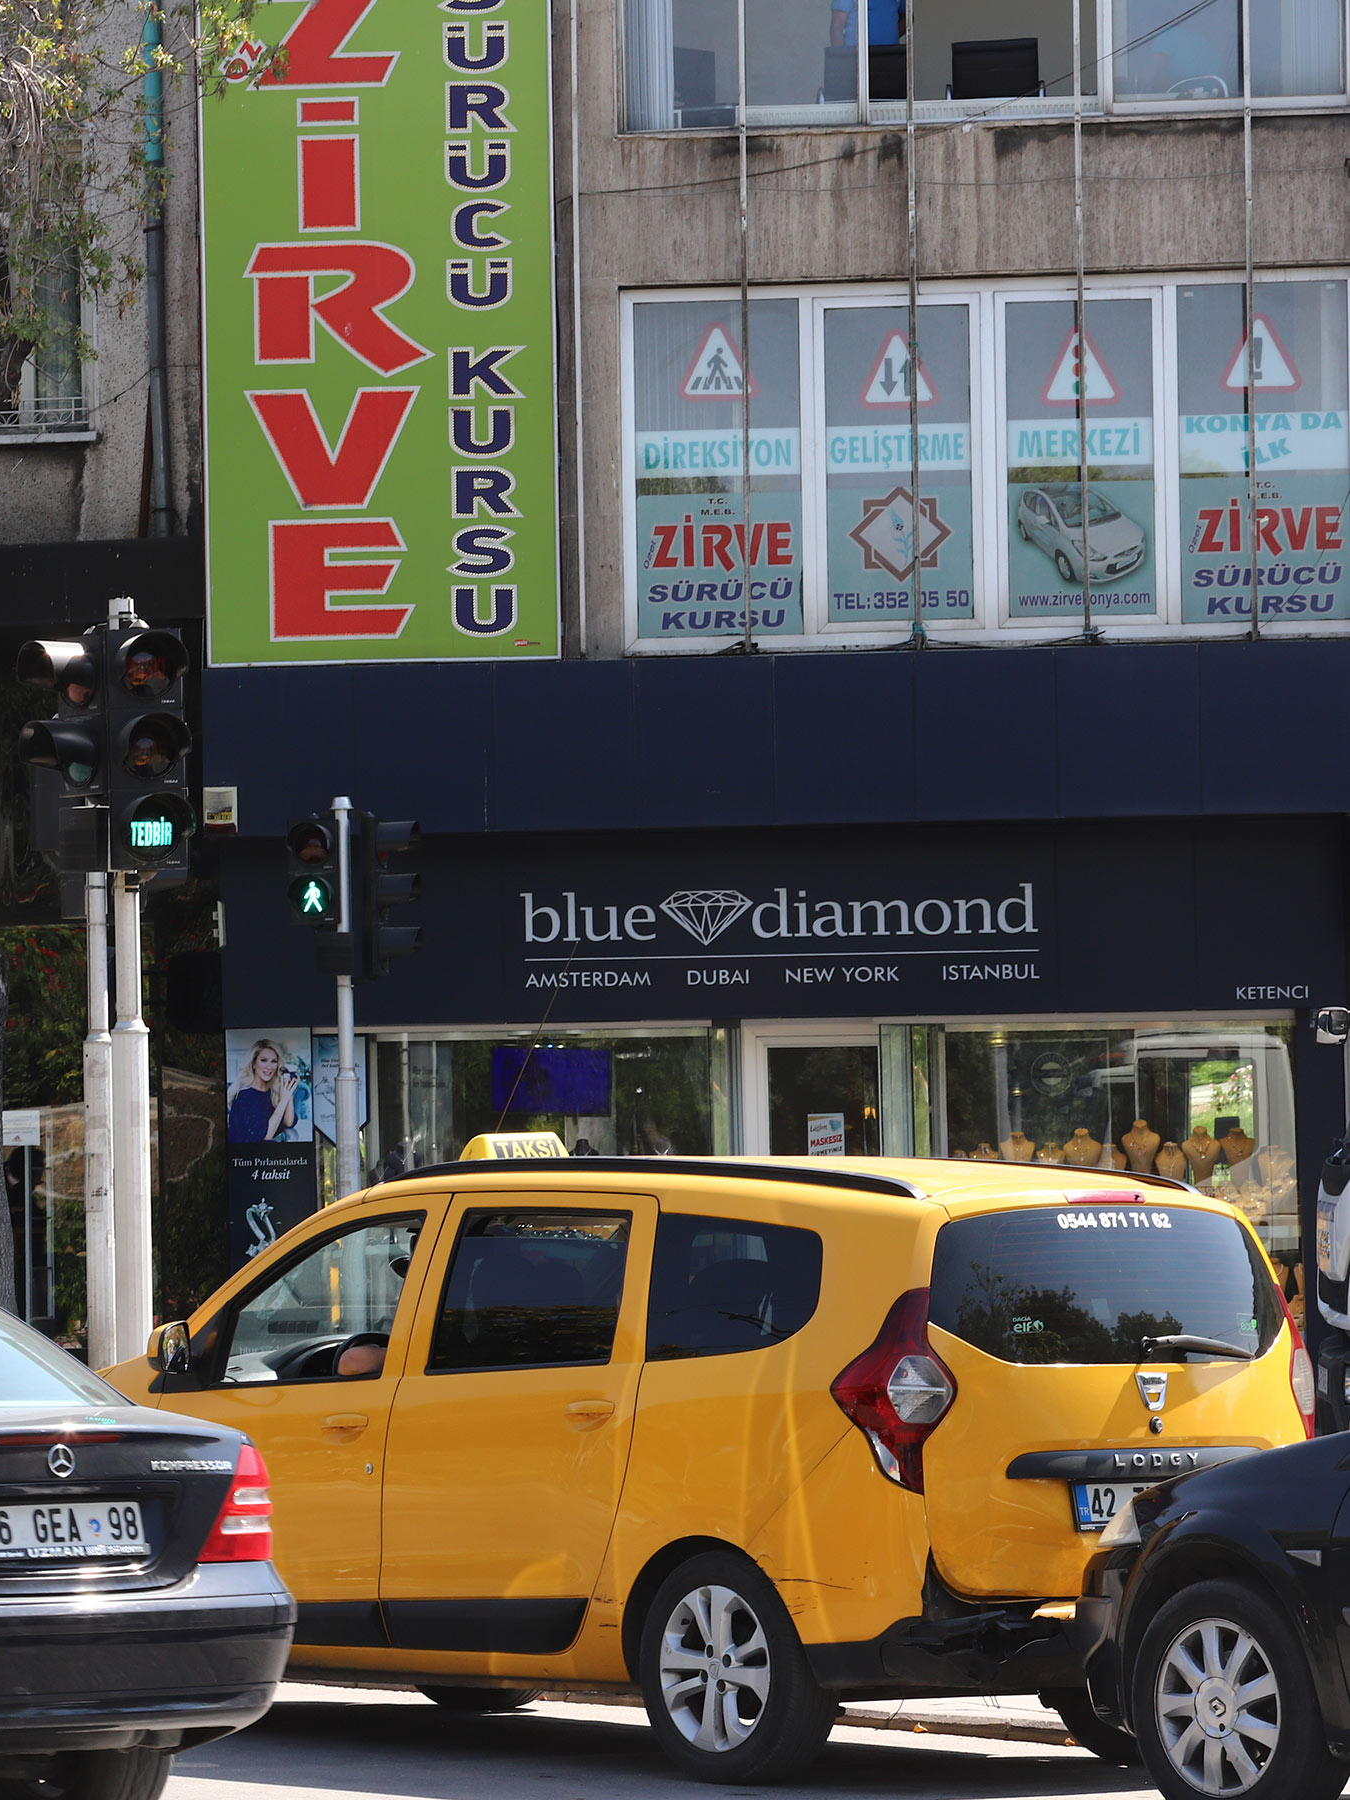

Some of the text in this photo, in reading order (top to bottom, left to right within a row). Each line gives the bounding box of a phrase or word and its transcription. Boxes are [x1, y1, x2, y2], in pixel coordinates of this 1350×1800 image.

[437, 0, 526, 638] ÜRÜCÜ KURSU
[644, 434, 792, 470] DİREKSİYON
[830, 429, 964, 469] GELİŞTİRME
[1018, 423, 1141, 458] MERKEZİ
[1241, 437, 1293, 469] İLK
[700, 508, 736, 516] M.E.B.
[1197, 498, 1344, 557] ZİRVE
[652, 514, 794, 572] ZİRVE
[1193, 562, 1343, 588] SÜRÜCÜ
[648, 578, 794, 603] SÜRÜCÜ
[946, 589, 970, 608] 50
[1018, 591, 1151, 609] www.zirveonya.com
[1207, 594, 1335, 616] KURSU
[661, 609, 786, 630] KURSU
[130, 815, 173, 847] TEDBİR
[521, 883, 1039, 944] blue diamond
[524, 963, 1041, 989] AMSTERDAM DUBAI NEW YORK ISTANBUL
[1235, 985, 1311, 1000] KETENCI
[232, 1158, 252, 1167] Tüm
[251, 1168, 291, 1180] 4 taksit
[1056, 1212, 1172, 1230] 0544 871 71 62
[1013, 1321, 1033, 1333] elf
[1114, 1451, 1199, 1467] LODGY
[1079, 1487, 1116, 1518] TR 42
[33, 1507, 82, 1543] GEA
[108, 1505, 139, 1541] 98
[26, 1545, 87, 1559] UZMAN
